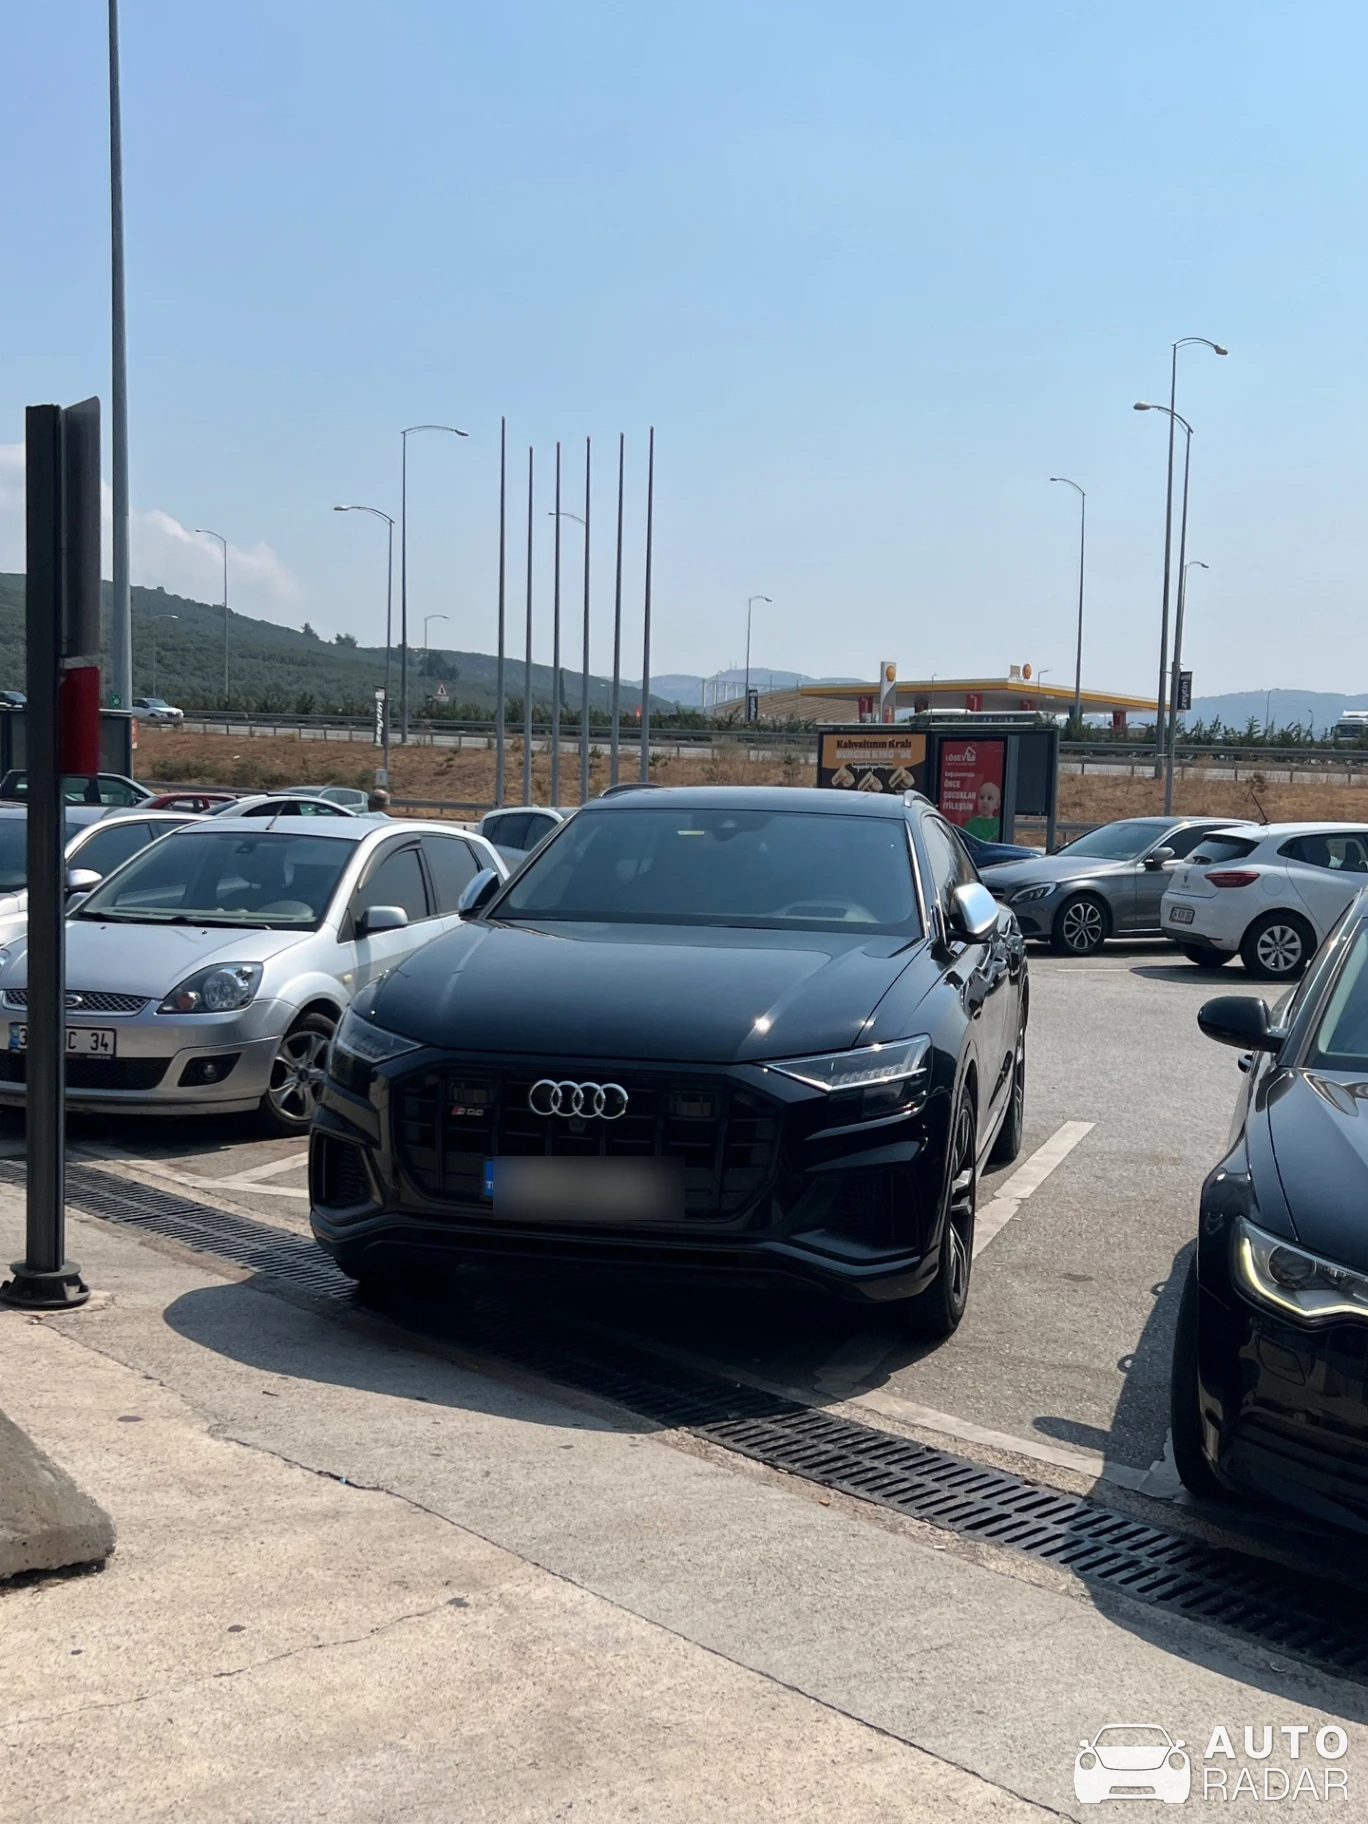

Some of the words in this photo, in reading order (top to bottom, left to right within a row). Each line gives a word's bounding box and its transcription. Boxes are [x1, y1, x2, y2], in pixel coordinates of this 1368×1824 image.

[1181, 681, 1190, 709] zeytin
[836, 749, 871, 759] BURGER
[872, 749, 895, 759] KING
[945, 754, 966, 762] LÖSEV
[943, 778, 961, 788] ÖNCE
[943, 791, 977, 800] ÇOCUKLAR
[942, 801, 974, 812] İYİLEŞSİN
[90, 1032, 109, 1051] 34
